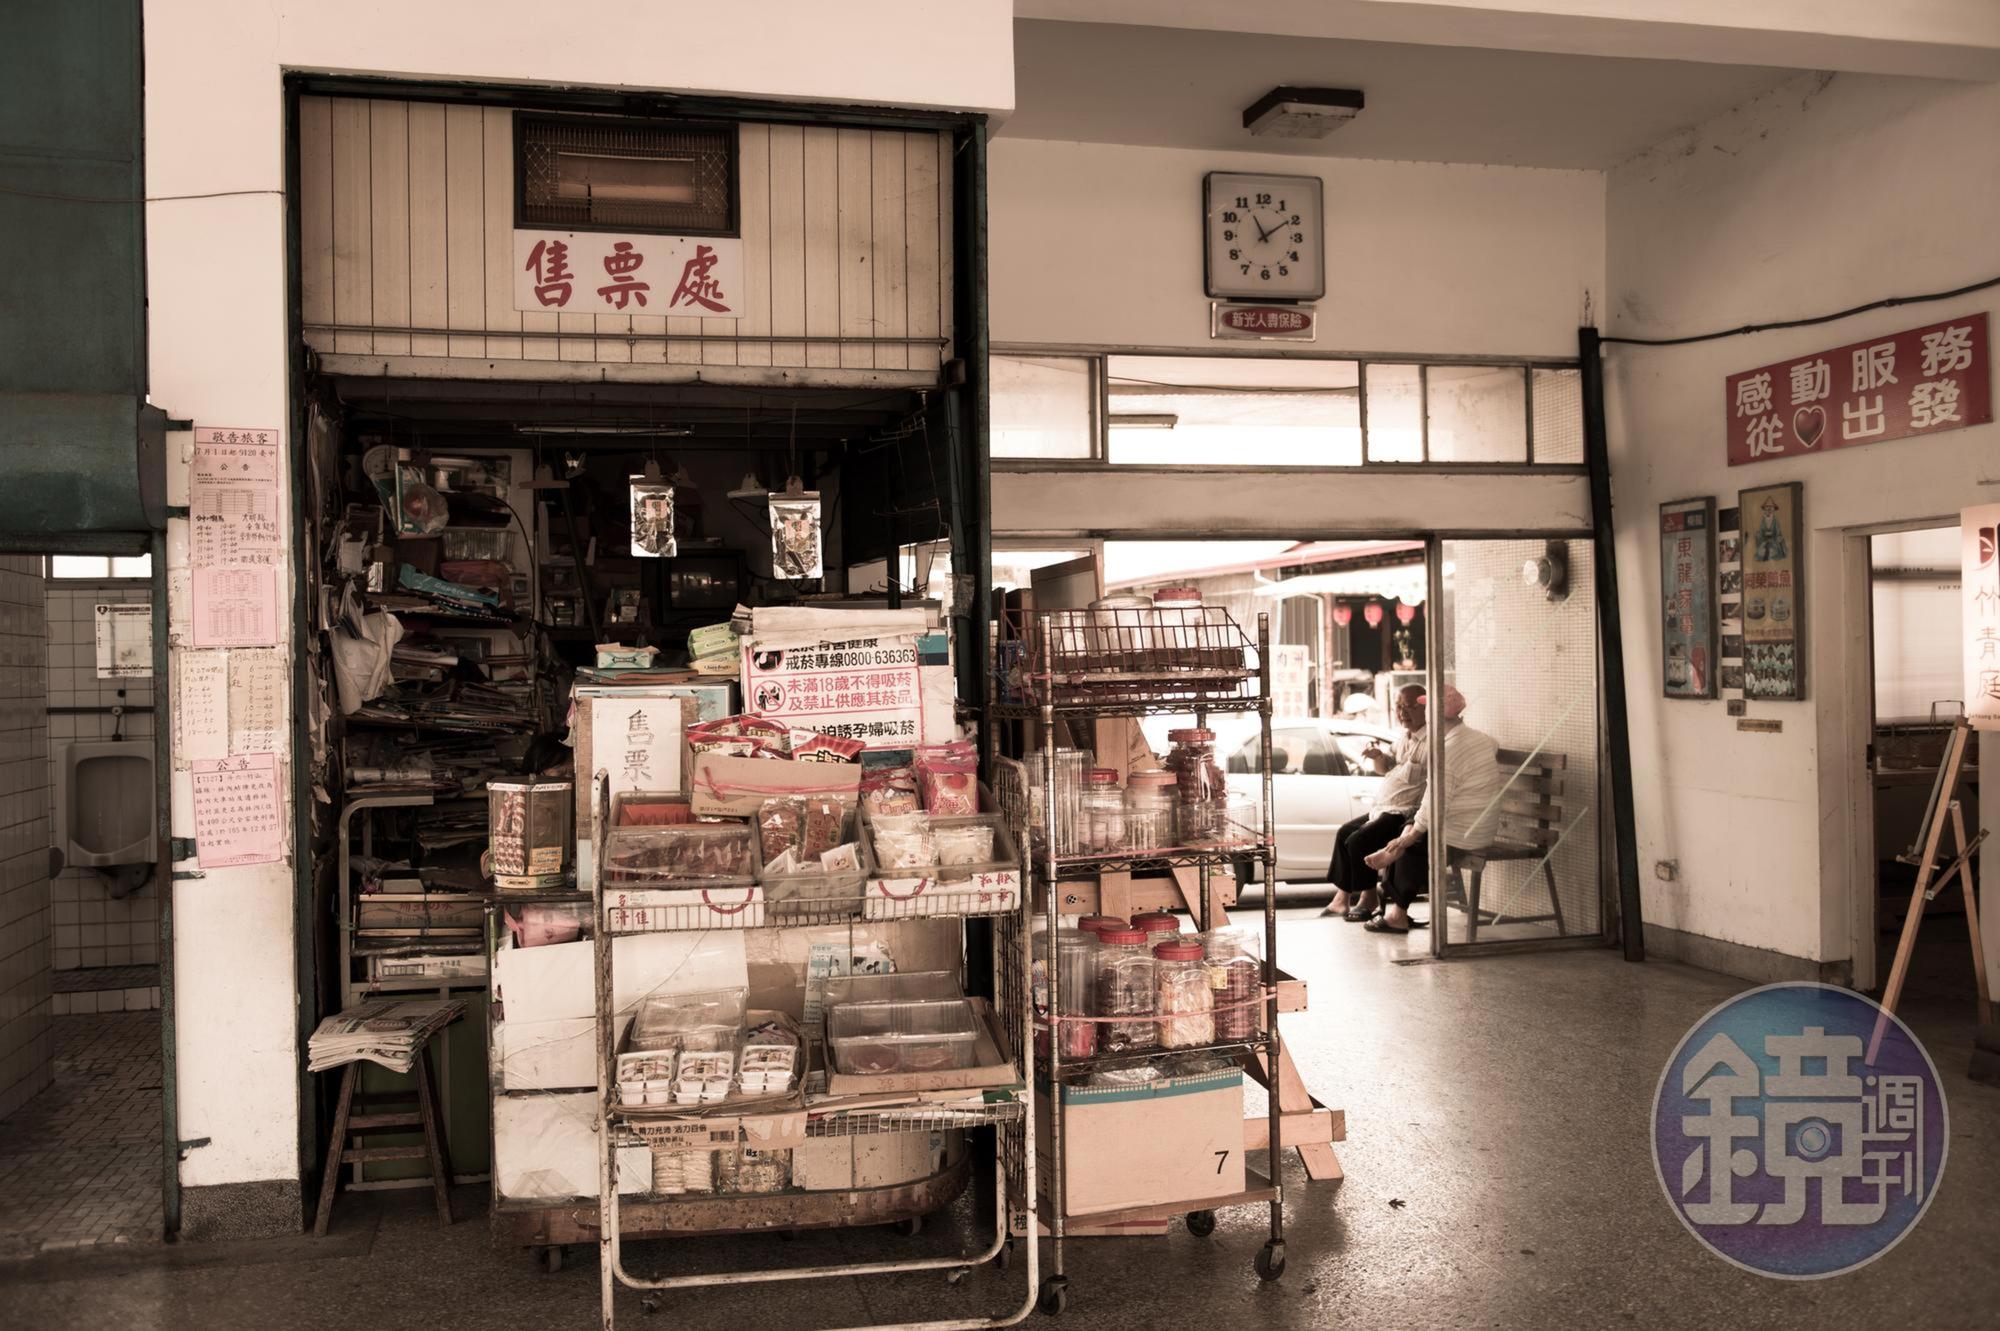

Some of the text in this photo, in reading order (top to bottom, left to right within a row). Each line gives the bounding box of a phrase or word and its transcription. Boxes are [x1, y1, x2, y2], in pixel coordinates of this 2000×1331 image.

[1235, 197, 1248, 208] 11
[1255, 193, 1271, 205] 12
[1280, 200, 1286, 211] 1
[1222, 212, 1237, 223] 10
[1291, 215, 1300, 225] 2
[1224, 230, 1233, 241] 9
[1294, 233, 1303, 243] 3
[1229, 249, 1239, 260] 8
[1289, 251, 1299, 262] 4
[526, 238, 731, 313] 售票處
[1240, 264, 1249, 275] 7
[1260, 269, 1270, 280] 6
[1279, 266, 1288, 276] 5
[1231, 311, 1302, 329] 新光人壽保險
[1735, 326, 1974, 418] 感動服務
[212, 431, 268, 445] 敬告旅客
[788, 638, 879, 653] 有害健康
[1974, 584, 2000, 704] 竹青庭
[787, 671, 912, 694] 未滿18歲不得吸菸
[788, 689, 913, 712] 及禁止供應其菸品
[622, 708, 654, 796] 售票
[216, 758, 250, 771] 公告
[1214, 1149, 1230, 1176] 7
